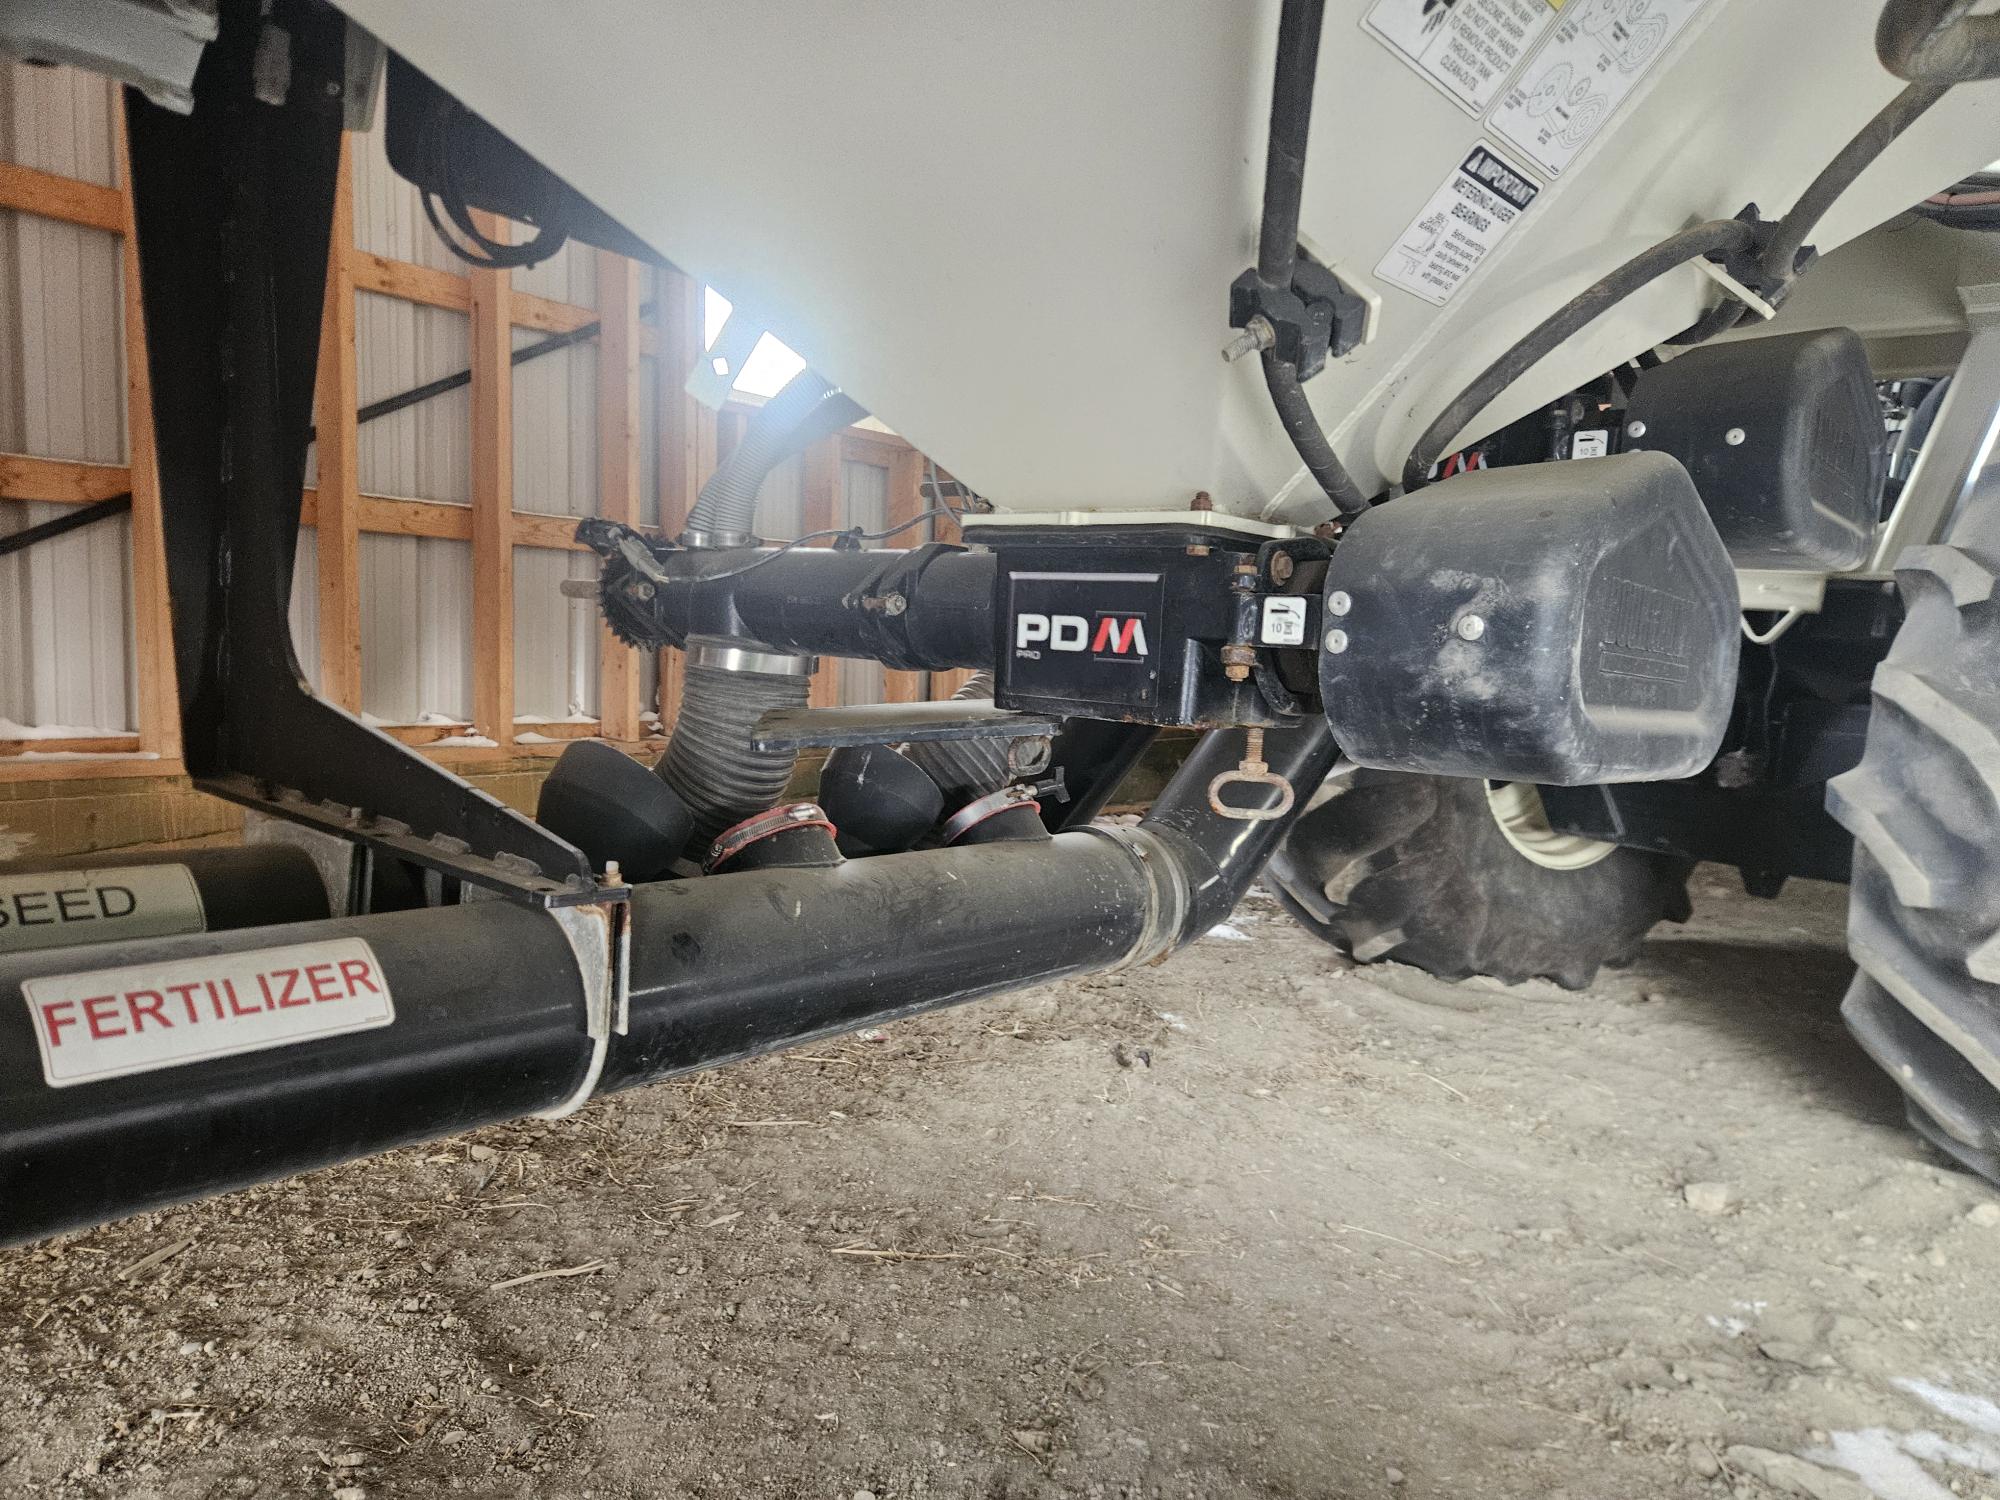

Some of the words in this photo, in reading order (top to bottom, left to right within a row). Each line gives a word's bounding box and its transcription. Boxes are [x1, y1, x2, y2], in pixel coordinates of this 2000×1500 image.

[1449, 15, 1461, 31] TO
[1459, 23, 1486, 52] REMOVE
[1481, 45, 1512, 73] PRODUCT
[1462, 3, 1477, 19] DO
[1473, 12, 1489, 31] NOT
[1484, 24, 1500, 42] USE
[1448, 36, 1477, 69] THROUGH
[1476, 61, 1494, 81] TANK
[1452, 176, 1493, 209] METERING
[1489, 202, 1516, 224] AUGER
[1477, 157, 1537, 206] IMPORTANT
[1451, 202, 1491, 232] BEARINGS
[1016, 613, 1148, 655] PDM
[1271, 623, 1282, 633] 10
[1016, 649, 1041, 660] PRO
[41, 959, 380, 1048] FERTILIZER
